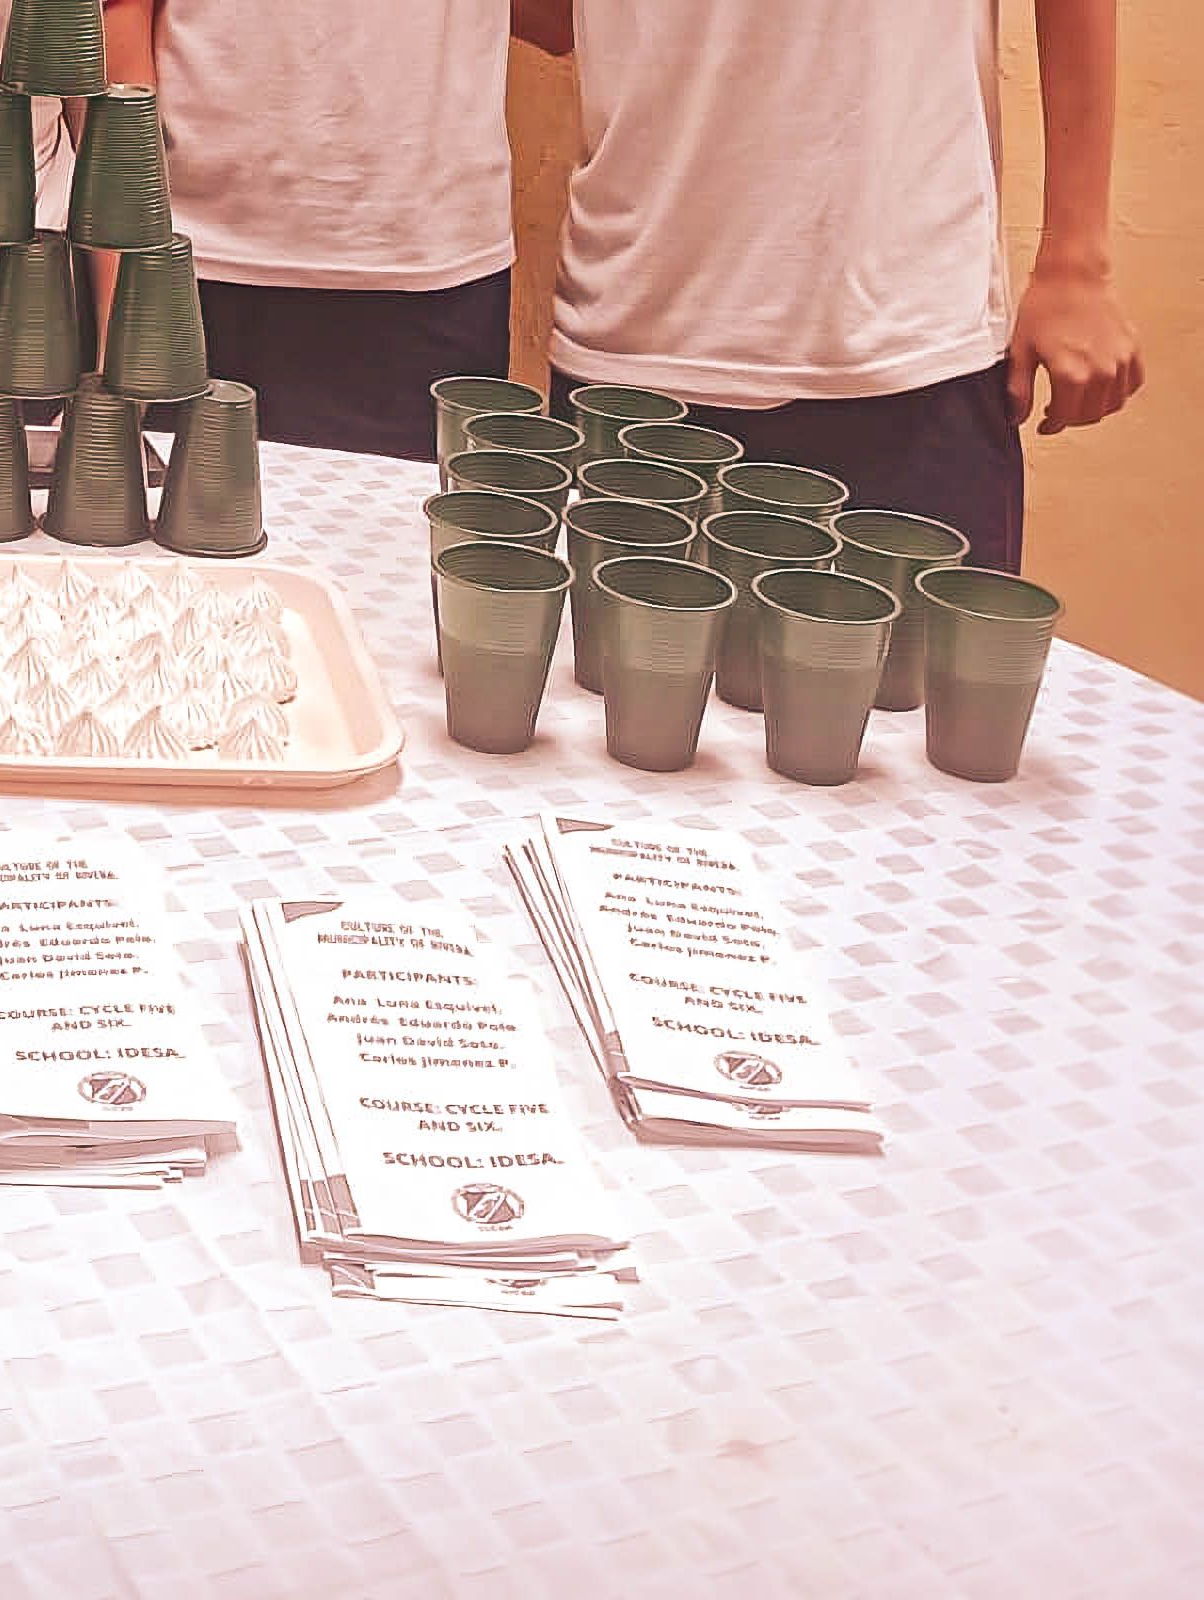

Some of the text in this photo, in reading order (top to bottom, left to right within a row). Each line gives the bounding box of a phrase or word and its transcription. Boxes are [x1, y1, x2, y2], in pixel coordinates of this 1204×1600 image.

[446, 1104, 504, 1115] CYCLE
[509, 1104, 549, 1114] FIVE
[419, 1120, 460, 1132] AND
